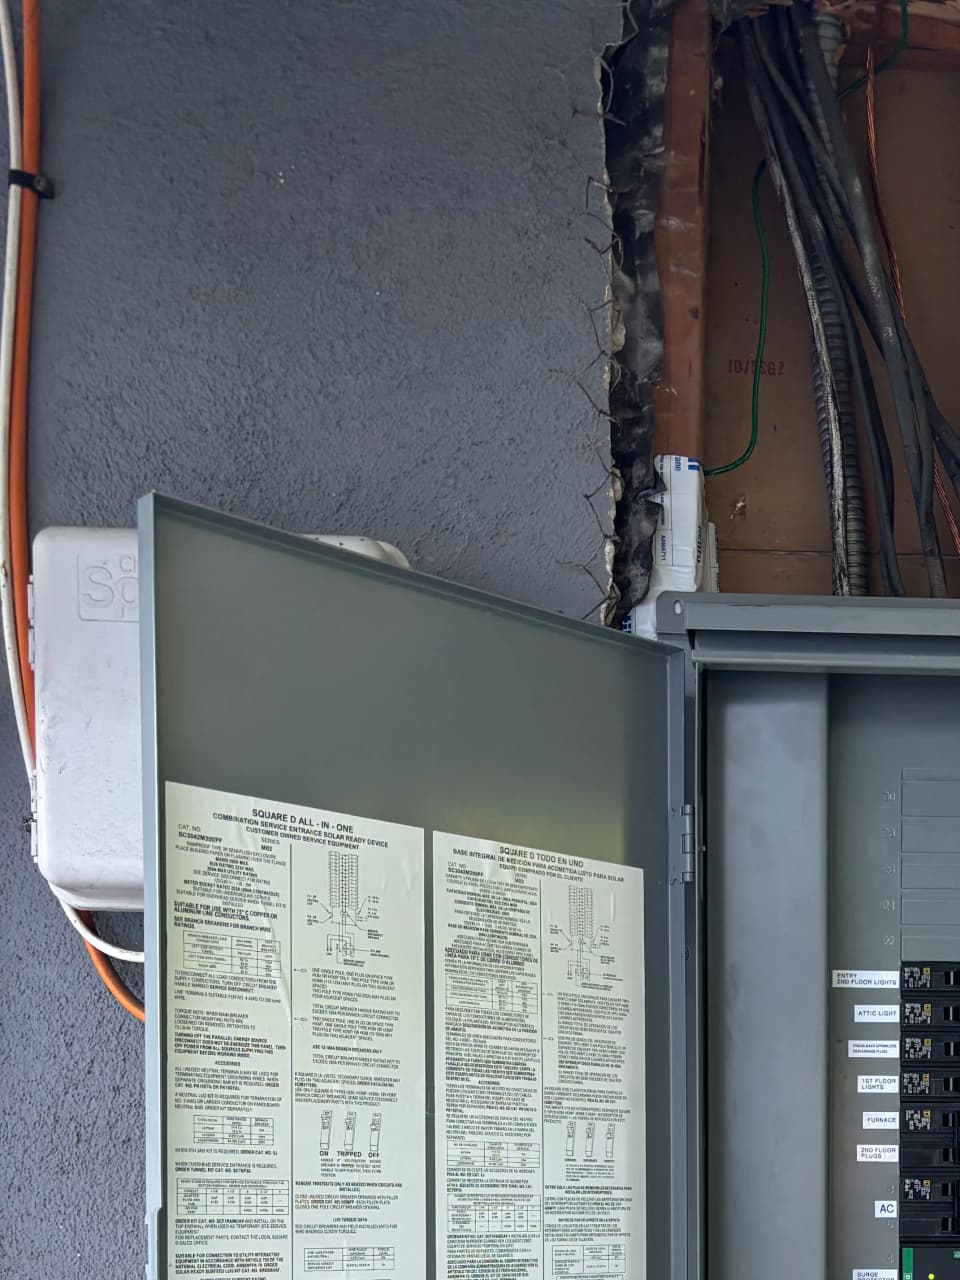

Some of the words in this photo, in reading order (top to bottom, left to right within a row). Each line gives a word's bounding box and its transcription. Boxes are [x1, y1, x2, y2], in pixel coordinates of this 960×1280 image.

[212, 812, 258, 826] COMBINATION
[260, 820, 288, 831] SERVICE
[289, 825, 322, 837] ENTRANCE
[324, 832, 344, 841] SOLAR
[346, 835, 366, 844] READY
[367, 838, 389, 848] DEVICE
[252, 808, 288, 822] SQUARE
[290, 815, 296, 824] D
[299, 817, 314, 826] ALL
[322, 821, 330, 829] IN
[336, 824, 354, 834] ONE
[246, 826, 279, 837] CUSTOMER
[280, 832, 302, 841] OWNED
[303, 836, 326, 845] SERVICE
[328, 840, 360, 850] EQUIPMENT
[469, 851, 496, 860] INTEGRAL
[500, 846, 528, 858] SQUARE
[537, 853, 556, 862] TODO
[558, 856, 567, 864] EN
[569, 859, 583, 868] UNO
[880, 1204, 894, 1214] AC
